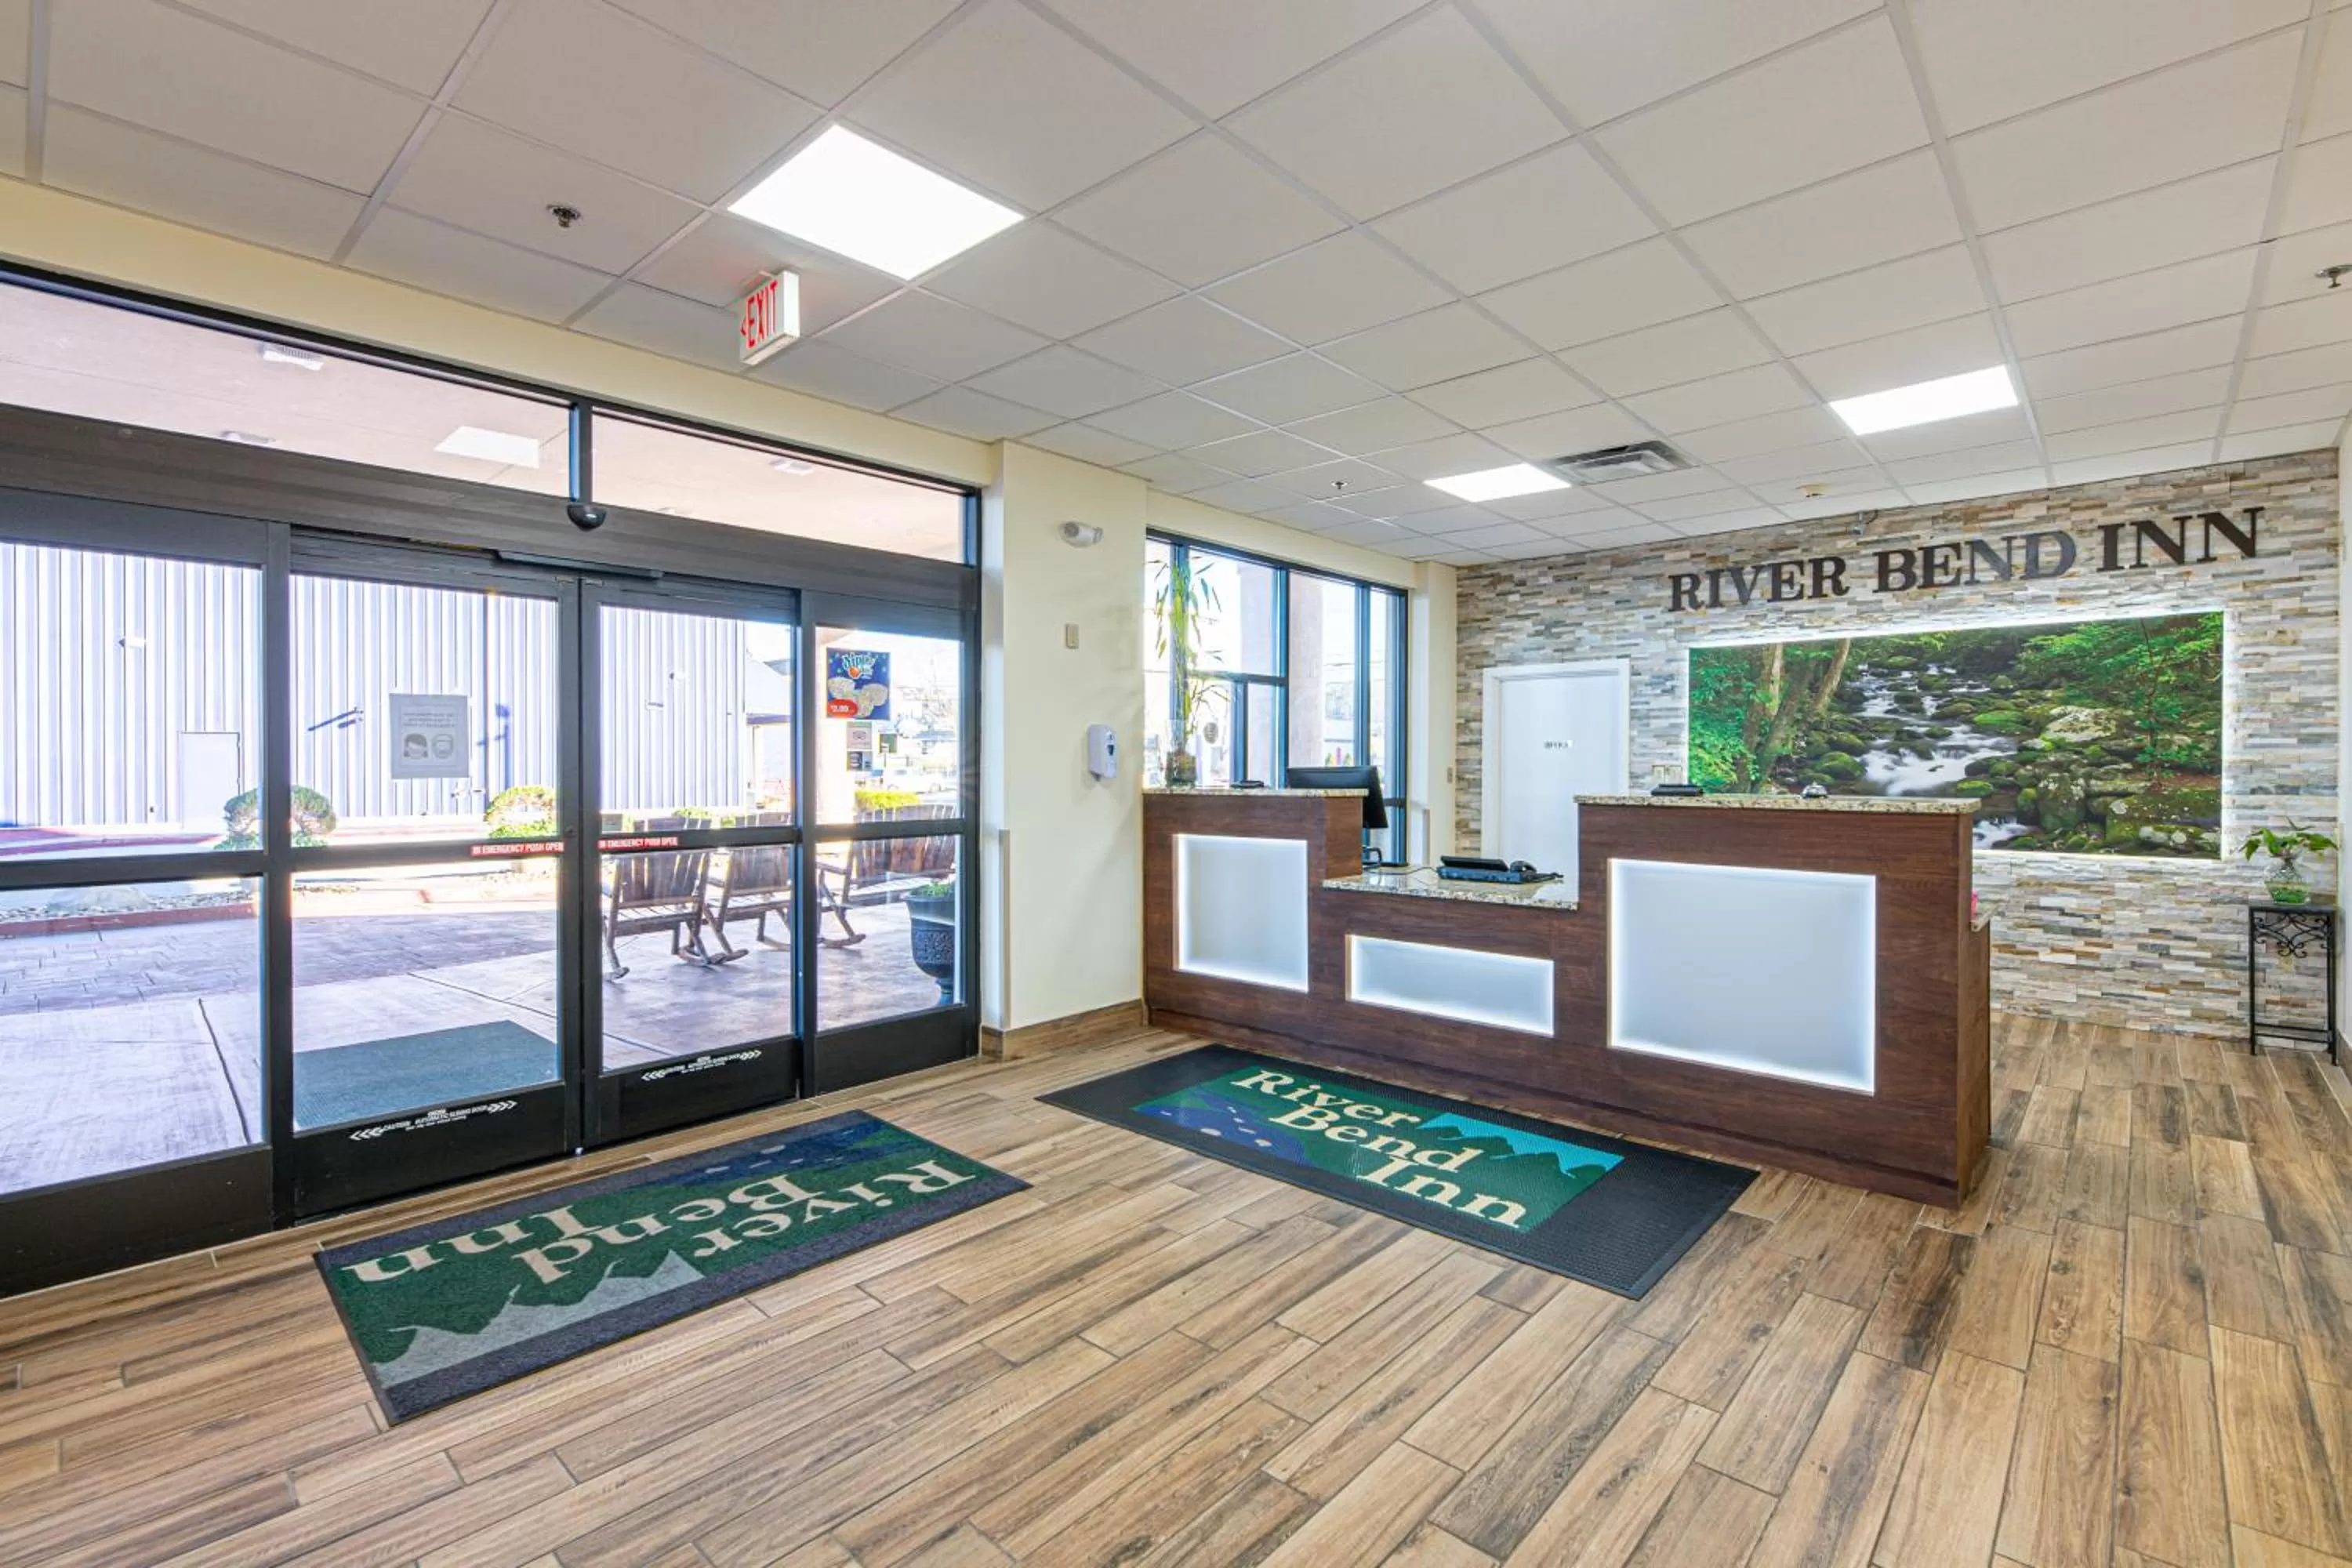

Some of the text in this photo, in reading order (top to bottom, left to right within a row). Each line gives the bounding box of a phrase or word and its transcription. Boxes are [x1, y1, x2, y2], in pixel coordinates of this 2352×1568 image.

[747, 280, 778, 348] EXIT
[1668, 506, 2264, 612] RIVER BEND INN
[483, 844, 524, 854] EMERGENCY
[526, 843, 544, 853] PUSH
[546, 841, 564, 851] OPEN
[1231, 1069, 1420, 1130] River
[1269, 1104, 1483, 1173] Bend
[513, 1174, 824, 1284] Bend
[695, 1160, 977, 1258] River
[1356, 1159, 1529, 1229] Inn
[343, 1204, 610, 1283] Inn
